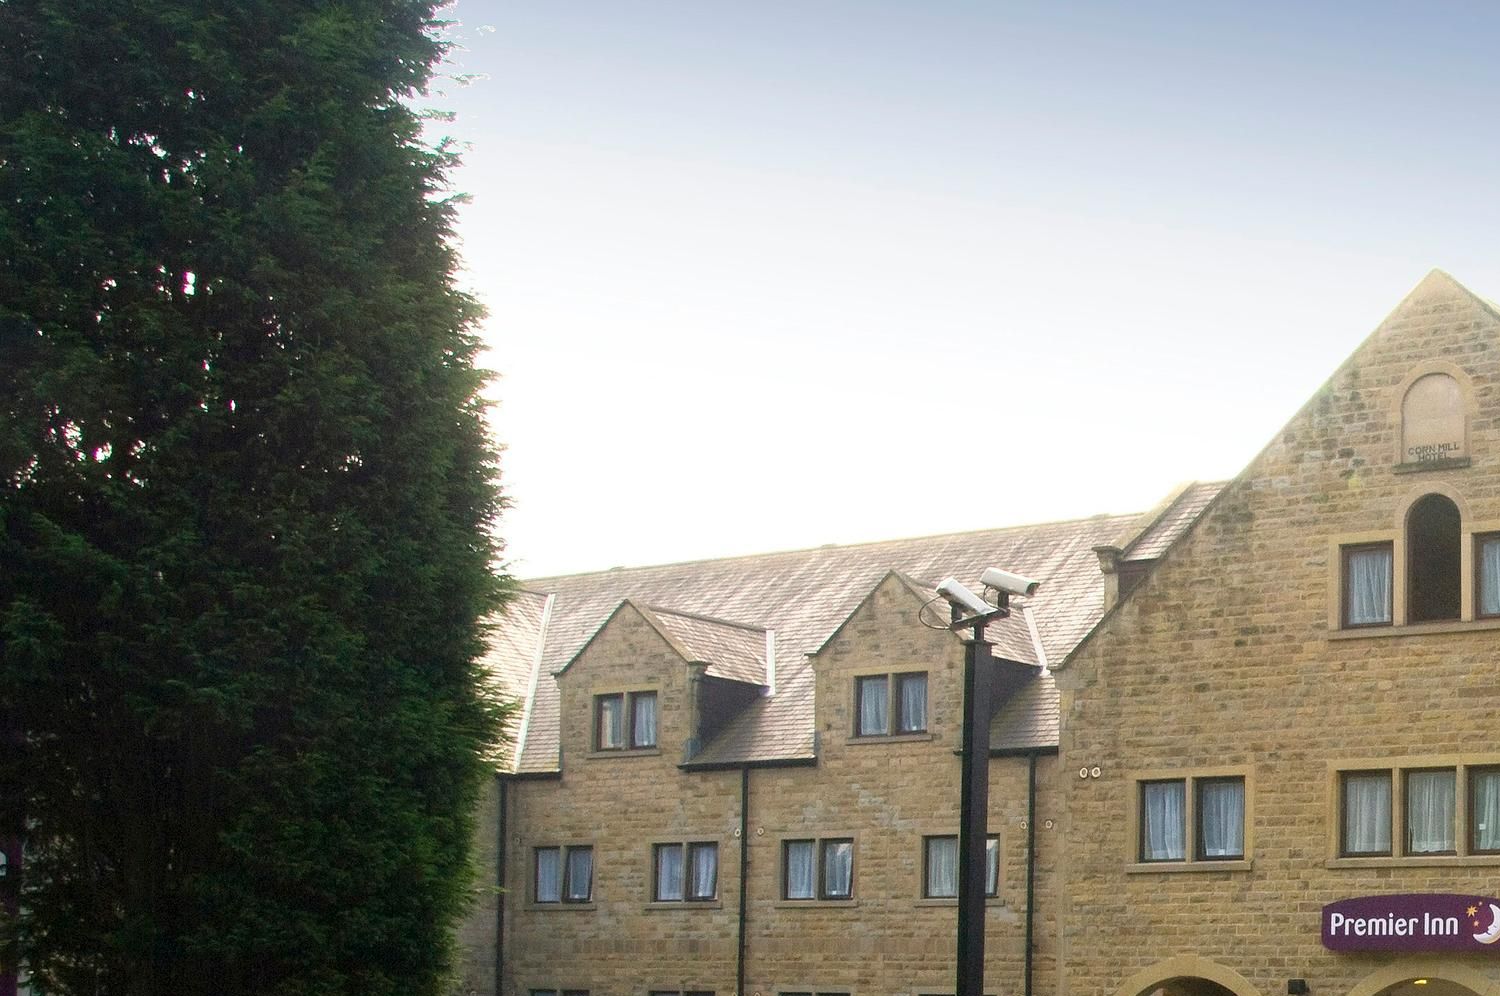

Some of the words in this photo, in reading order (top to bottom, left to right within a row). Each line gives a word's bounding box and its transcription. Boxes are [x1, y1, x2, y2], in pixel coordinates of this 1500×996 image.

[1408, 444, 1435, 456] CORN
[1438, 442, 1459, 452] MILL
[1330, 912, 1419, 936] Premier
[1424, 912, 1459, 936] Inn
